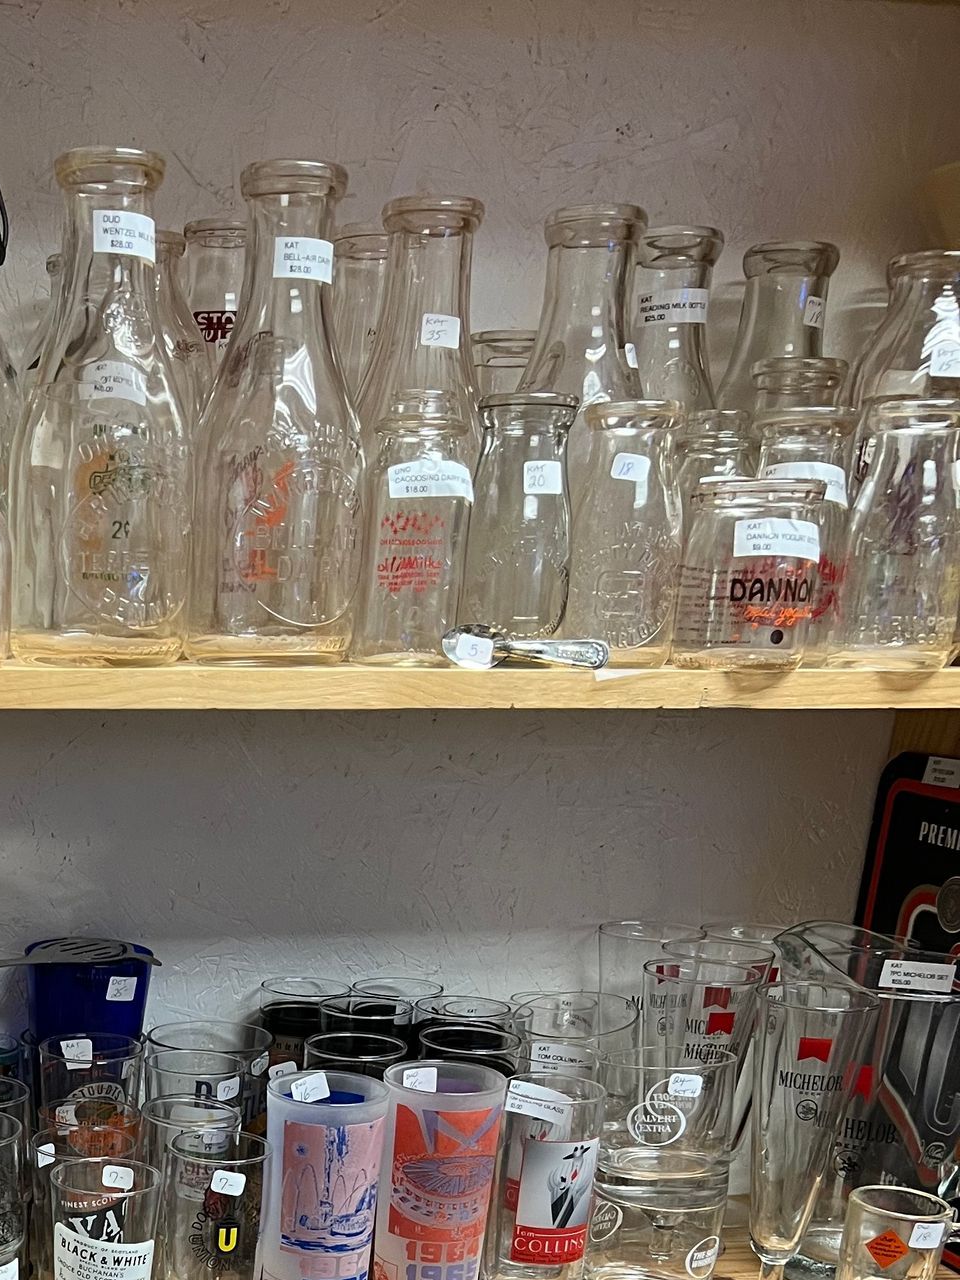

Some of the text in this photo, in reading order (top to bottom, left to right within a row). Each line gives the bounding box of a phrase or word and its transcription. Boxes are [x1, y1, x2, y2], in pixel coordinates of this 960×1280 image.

[102, 227, 136, 238] WENTZEL
[284, 241, 300, 249] KAT
[640, 303, 670, 313] READING
[746, 534, 779, 542] DANNON
[634, 1114, 678, 1123] CALVERT
[639, 1124, 672, 1133] EXTRA
[218, 1227, 238, 1252] U
[514, 1236, 584, 1254] COLLINS
[100, 1256, 108, 1265] &
[76, 1270, 91, 1280] OLD
[78, 1263, 124, 1279] BUCHANAN'S
